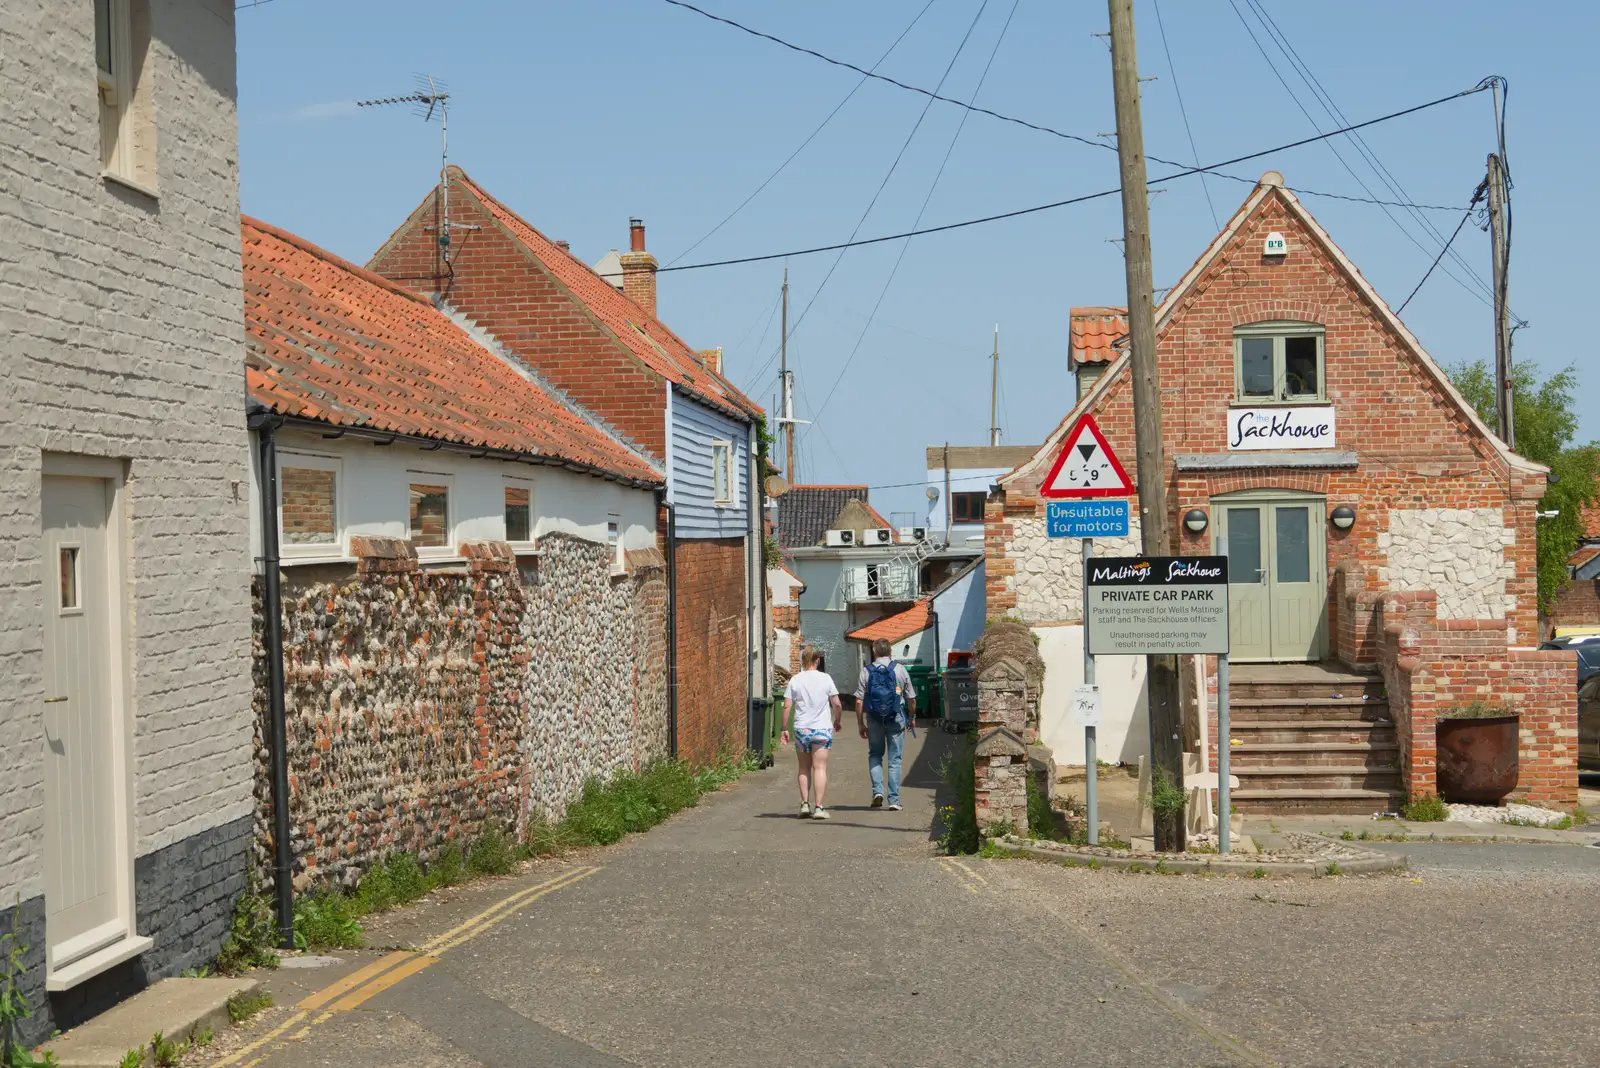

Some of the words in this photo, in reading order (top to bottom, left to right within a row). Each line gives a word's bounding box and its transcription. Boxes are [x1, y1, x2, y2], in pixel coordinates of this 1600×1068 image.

[1256, 413, 1270, 423] the
[1231, 412, 1330, 447] Sackhouse
[1051, 506, 1123, 518] Unsuitable
[1053, 522, 1072, 532] for
[1075, 521, 1123, 532] motors
[1092, 565, 1152, 582] Maltings
[1165, 560, 1222, 582] Sackhouse
[1102, 590, 1150, 601] PRIVATE
[1153, 590, 1178, 600] CAR
[1181, 590, 1214, 600] PARK
[1092, 607, 1120, 616] Parking
[1190, 606, 1224, 615] Maltings
[1161, 632, 1188, 640] parking
[1147, 640, 1175, 649] penalty
